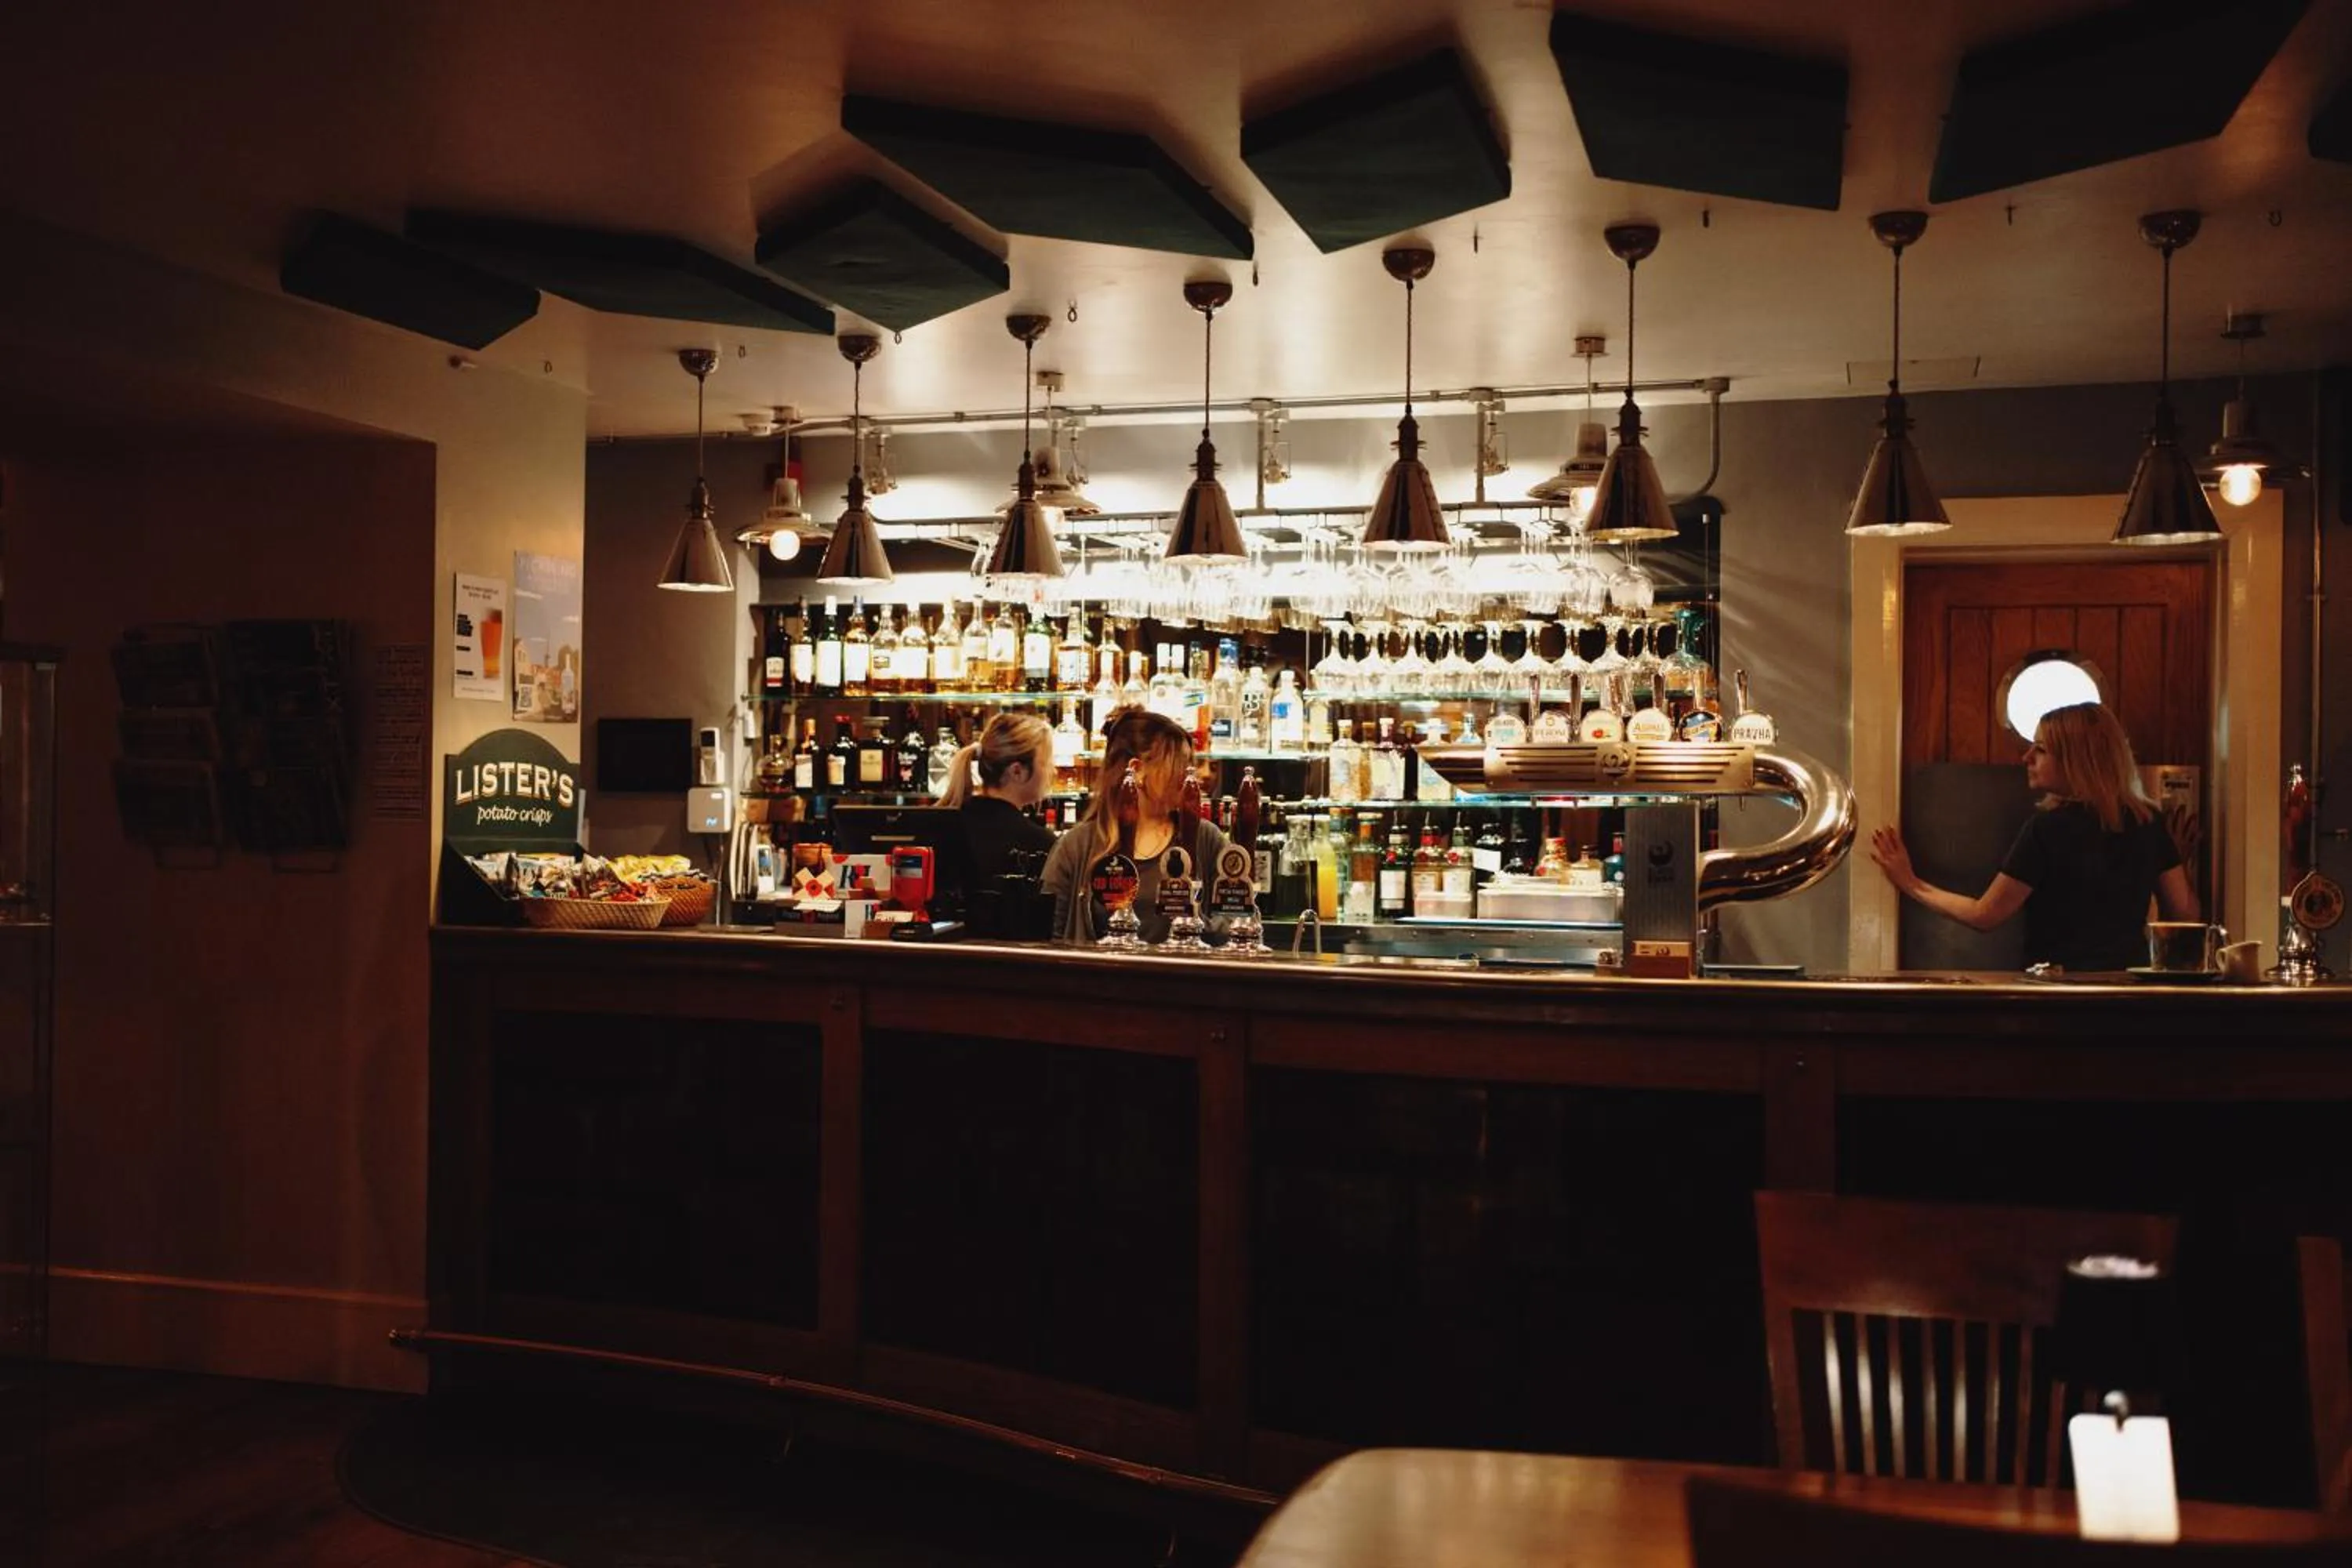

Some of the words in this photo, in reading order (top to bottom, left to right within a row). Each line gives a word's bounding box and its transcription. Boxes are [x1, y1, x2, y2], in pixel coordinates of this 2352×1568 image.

[455, 761, 574, 808] LISTER'S
[477, 805, 517, 826] potato
[520, 807, 554, 826] crisps
